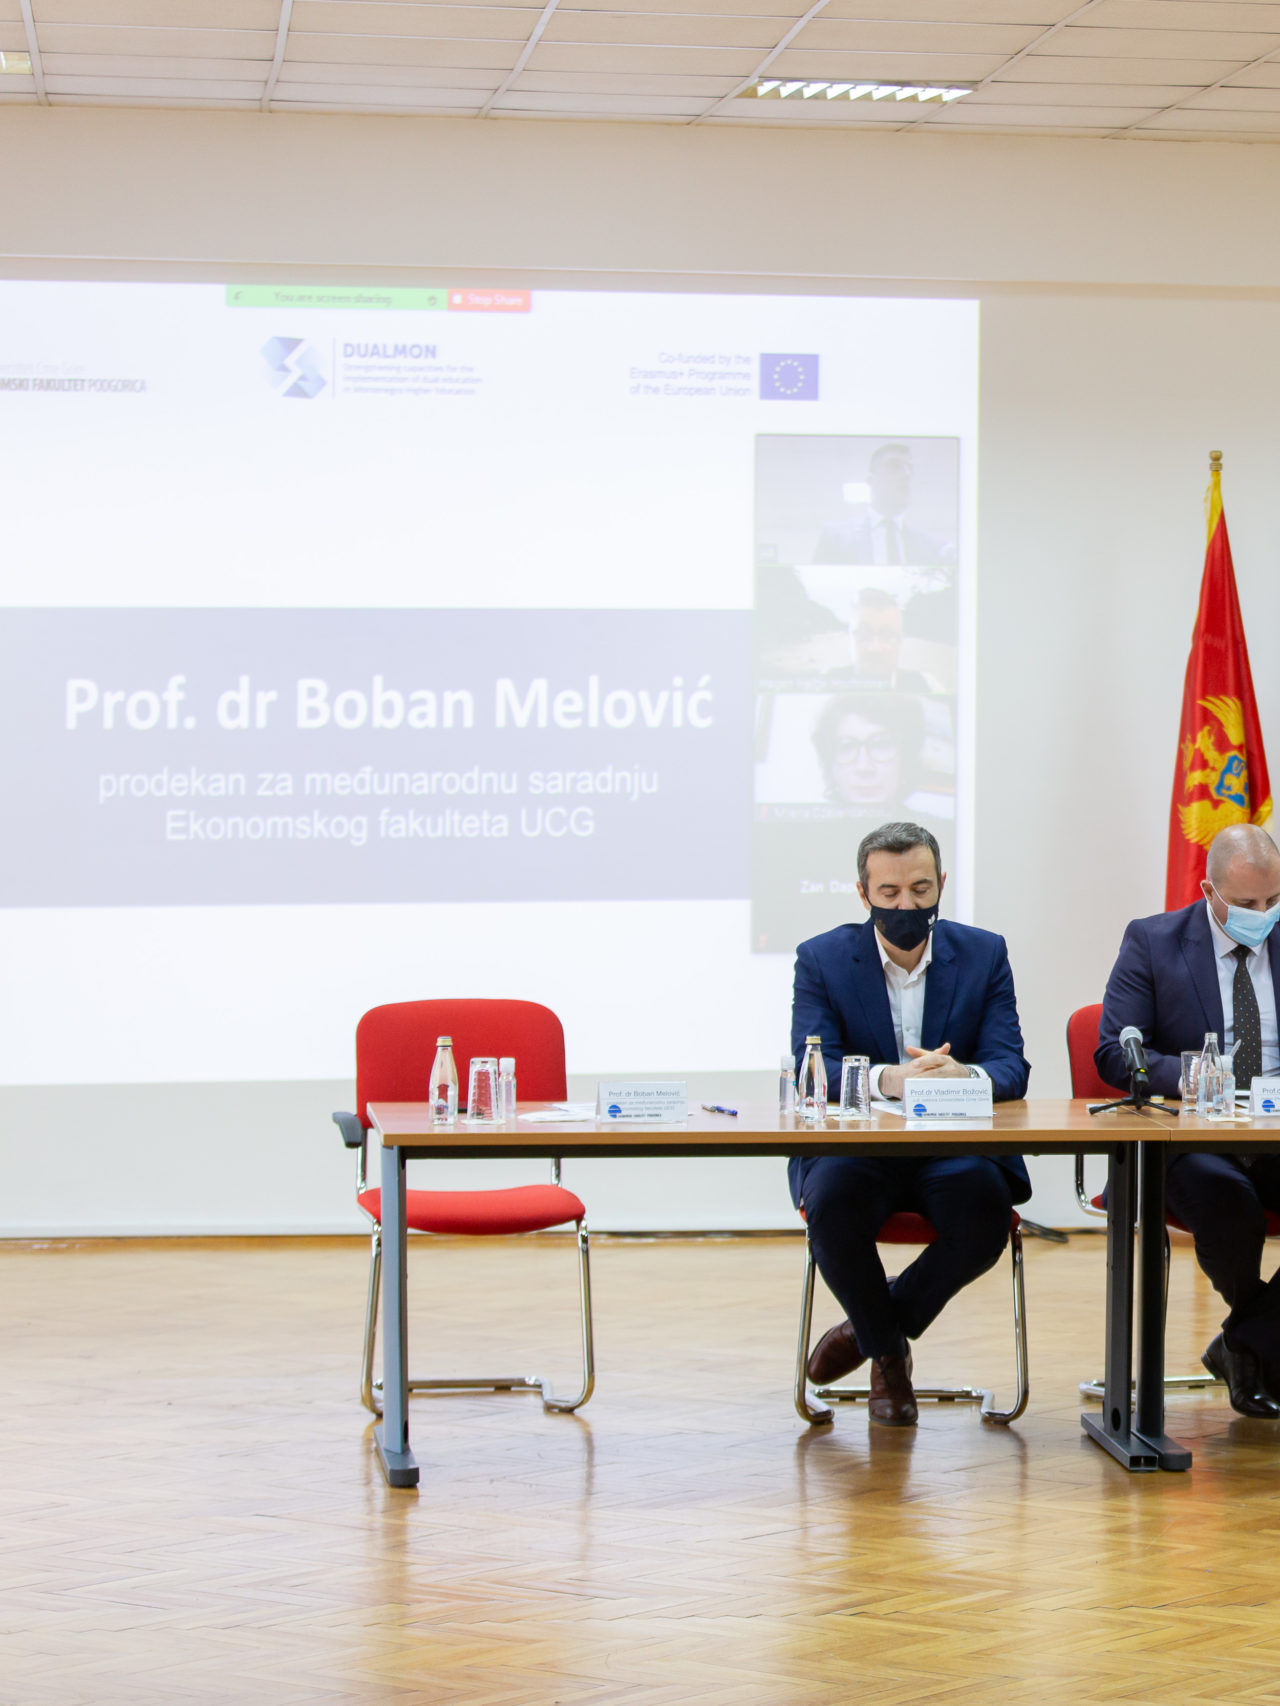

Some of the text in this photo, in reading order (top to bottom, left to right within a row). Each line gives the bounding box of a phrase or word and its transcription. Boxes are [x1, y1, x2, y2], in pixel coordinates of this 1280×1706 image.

[343, 342, 437, 360] DUALMON
[658, 351, 752, 366] Co-funded by the
[630, 367, 752, 382] Erasmus+ Programme
[32, 377, 86, 392] FAKULTET
[629, 382, 752, 397] of the European Union
[65, 673, 713, 730] Prof. dr Boban Melović
[98, 763, 659, 804] prodekan za međunarodnu saradnju
[165, 805, 596, 846] Ekonomskog fakulteta UCG
[933, 1087, 962, 1096] Vladimir
